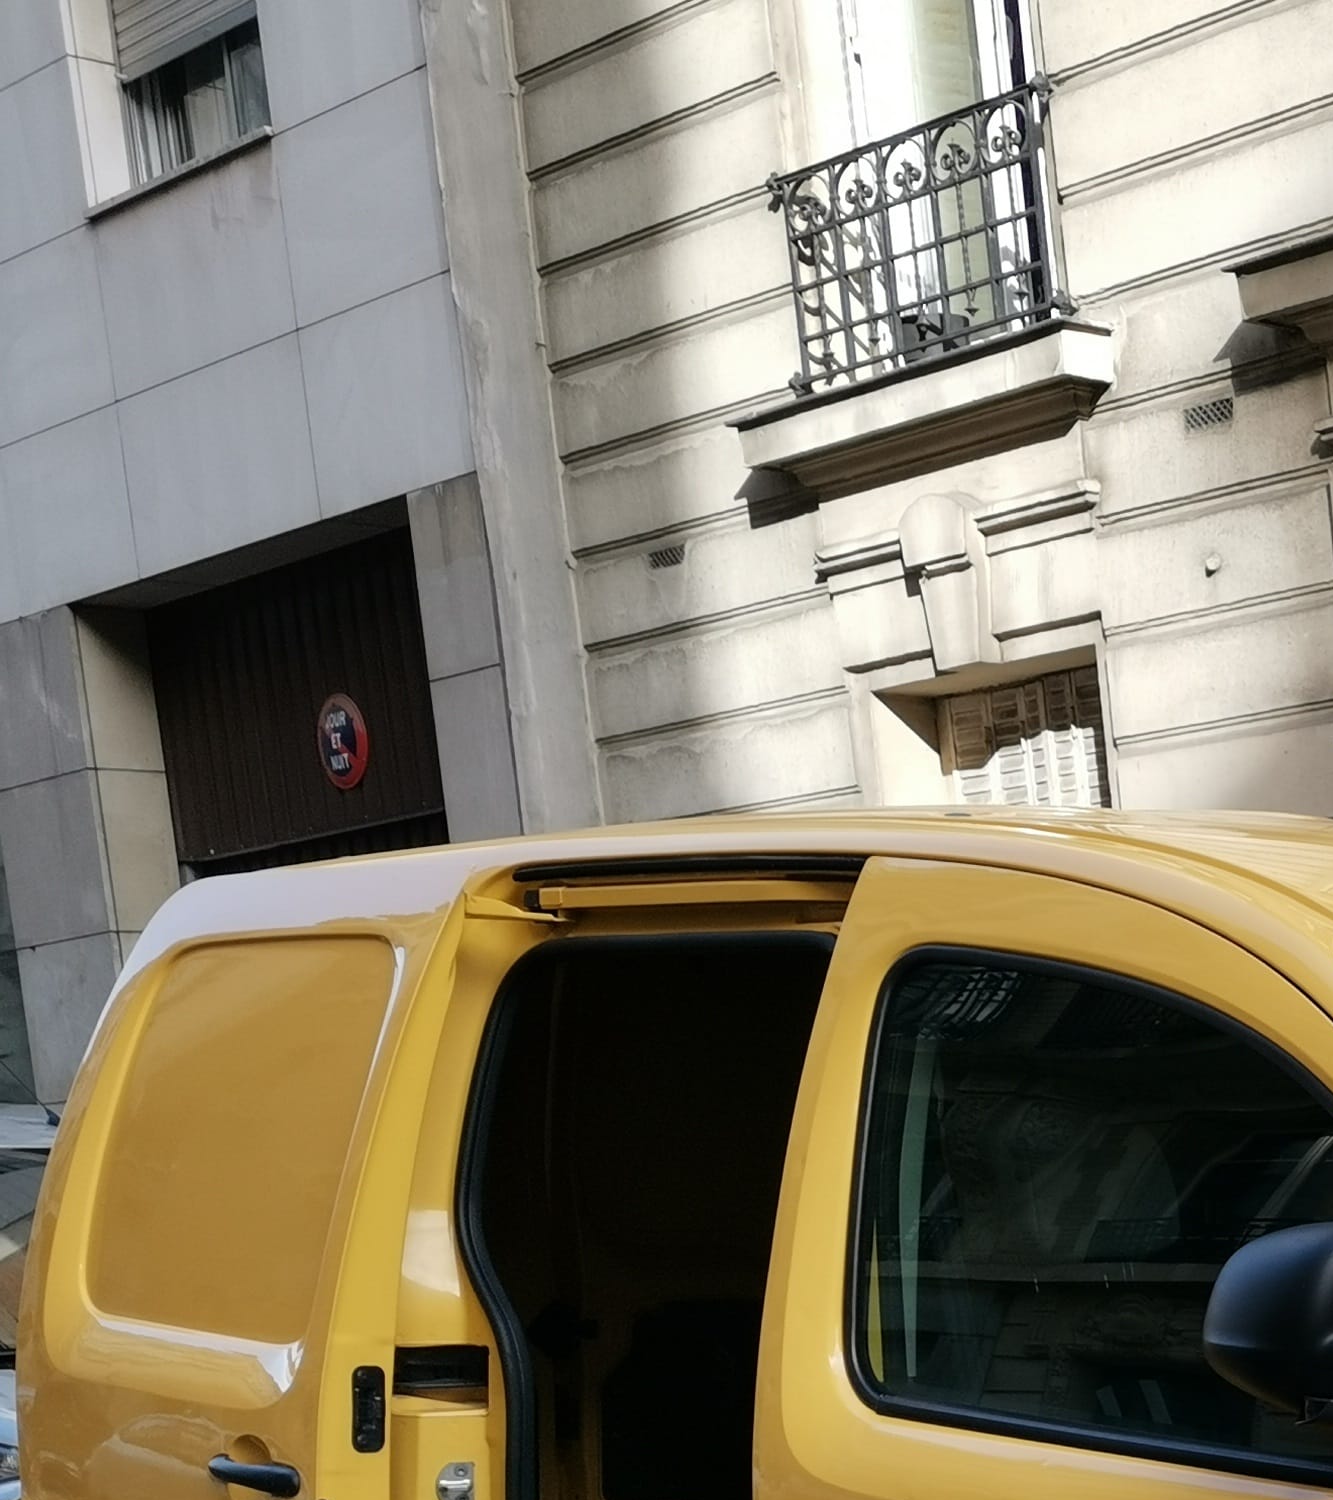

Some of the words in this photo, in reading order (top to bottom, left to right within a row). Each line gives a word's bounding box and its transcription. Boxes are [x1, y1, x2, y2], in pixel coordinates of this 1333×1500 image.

[325, 711, 346, 729] JOUR
[330, 732, 342, 749] ET
[329, 753, 350, 770] NUIT
